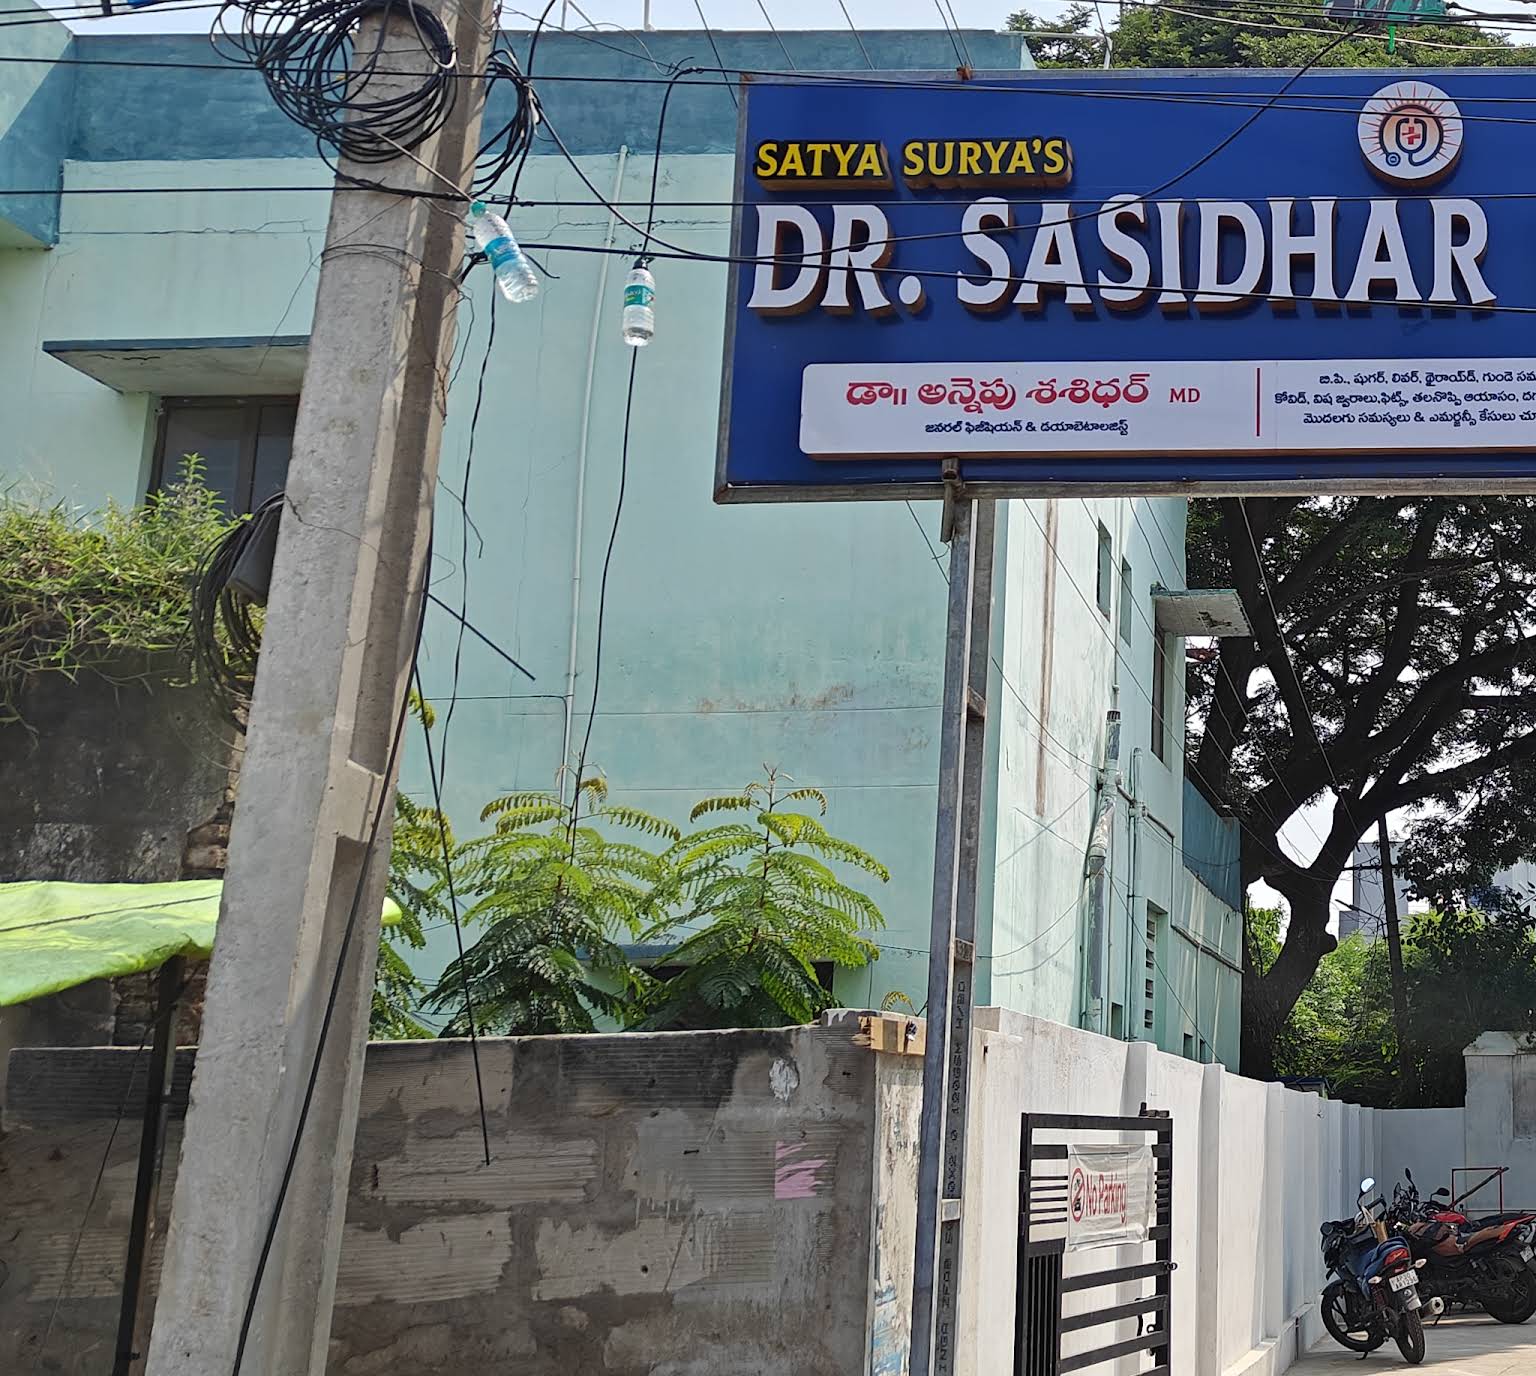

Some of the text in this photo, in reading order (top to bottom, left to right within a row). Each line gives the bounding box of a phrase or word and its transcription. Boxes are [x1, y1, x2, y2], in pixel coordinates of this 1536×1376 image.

[756, 136, 1067, 178] SATYA SURYA'S
[746, 199, 923, 312] DR.
[956, 194, 1497, 310] SASIDHAR
[1482, 371, 1514, 383] గుండె
[917, 377, 1017, 415] అన్నెపు
[1025, 372, 1151, 409] శశిధర్
[1168, 388, 1201, 403] MD
[1313, 393, 1333, 405] విష
[924, 419, 963, 433] జనరల్
[1025, 421, 1036, 432] &
[1413, 411, 1425, 422] &
[1478, 408, 1516, 421] కేసులు
[1085, 1172, 1127, 1223] No Parking
